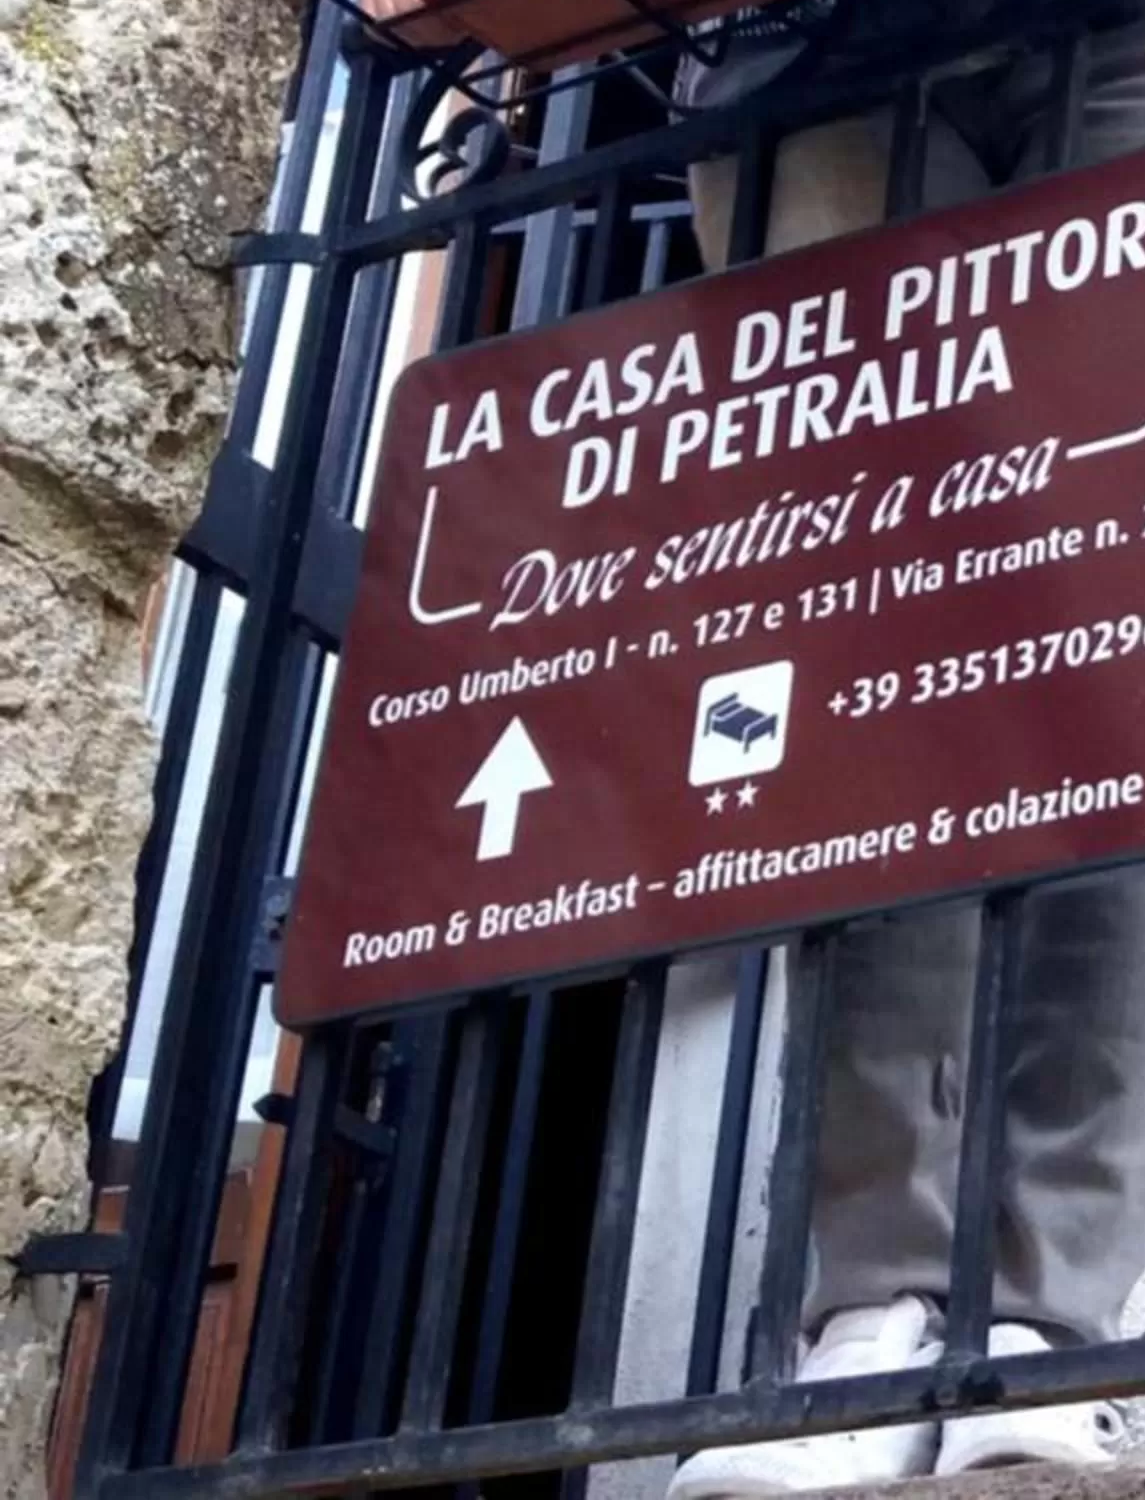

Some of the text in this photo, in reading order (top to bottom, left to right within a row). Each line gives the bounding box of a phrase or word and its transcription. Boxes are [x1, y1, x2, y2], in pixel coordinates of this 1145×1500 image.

[424, 389, 503, 470] LA
[530, 332, 704, 437] CASA
[731, 289, 856, 382] DEL
[562, 326, 1013, 509] DI PETRALIA
[369, 685, 450, 727] Corso
[459, 648, 596, 705] Umberto
[647, 630, 679, 659] n.
[693, 603, 755, 647] 127
[763, 602, 784, 630] e
[798, 578, 857, 621] 131
[891, 555, 944, 598] Via
[955, 527, 1085, 584] Errante
[1095, 519, 1129, 549] n.
[489, 437, 1060, 631] Dove sentirsi a casa
[828, 671, 900, 717] +39
[343, 924, 437, 967] Room
[444, 910, 471, 946] &
[478, 874, 640, 939] Breakfast
[673, 822, 917, 899] affittacamere
[927, 807, 956, 845] &
[965, 773, 1145, 837] colazione
